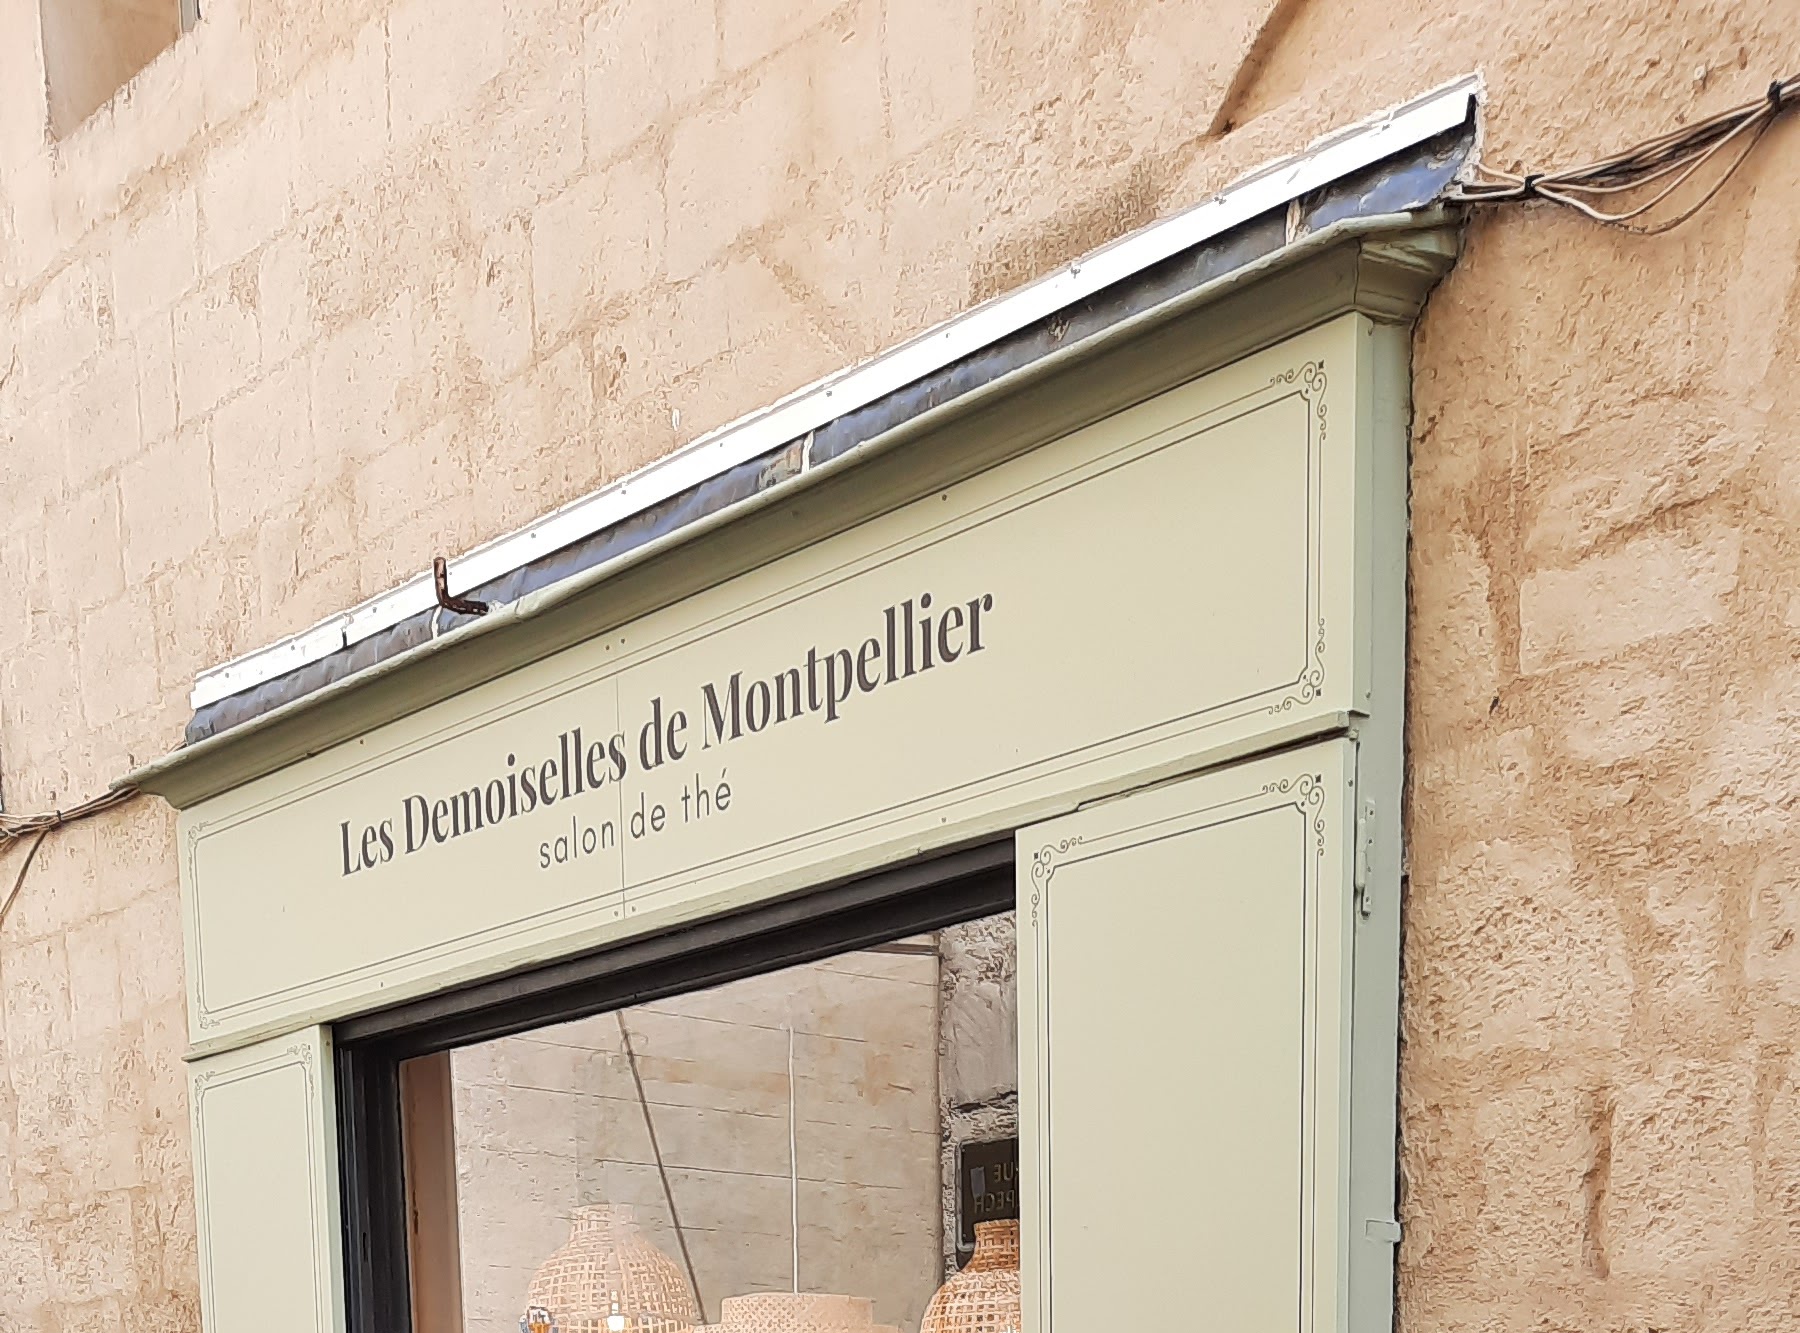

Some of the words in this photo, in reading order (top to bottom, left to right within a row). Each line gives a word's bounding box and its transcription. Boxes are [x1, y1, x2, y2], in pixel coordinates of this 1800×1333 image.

[340, 819, 394, 877] Les
[401, 727, 627, 855] Demoiselles
[639, 697, 688, 771] de
[700, 592, 993, 751] Montpellier
[539, 815, 615, 869] salon
[630, 792, 666, 840] de
[680, 767, 733, 823] thé
